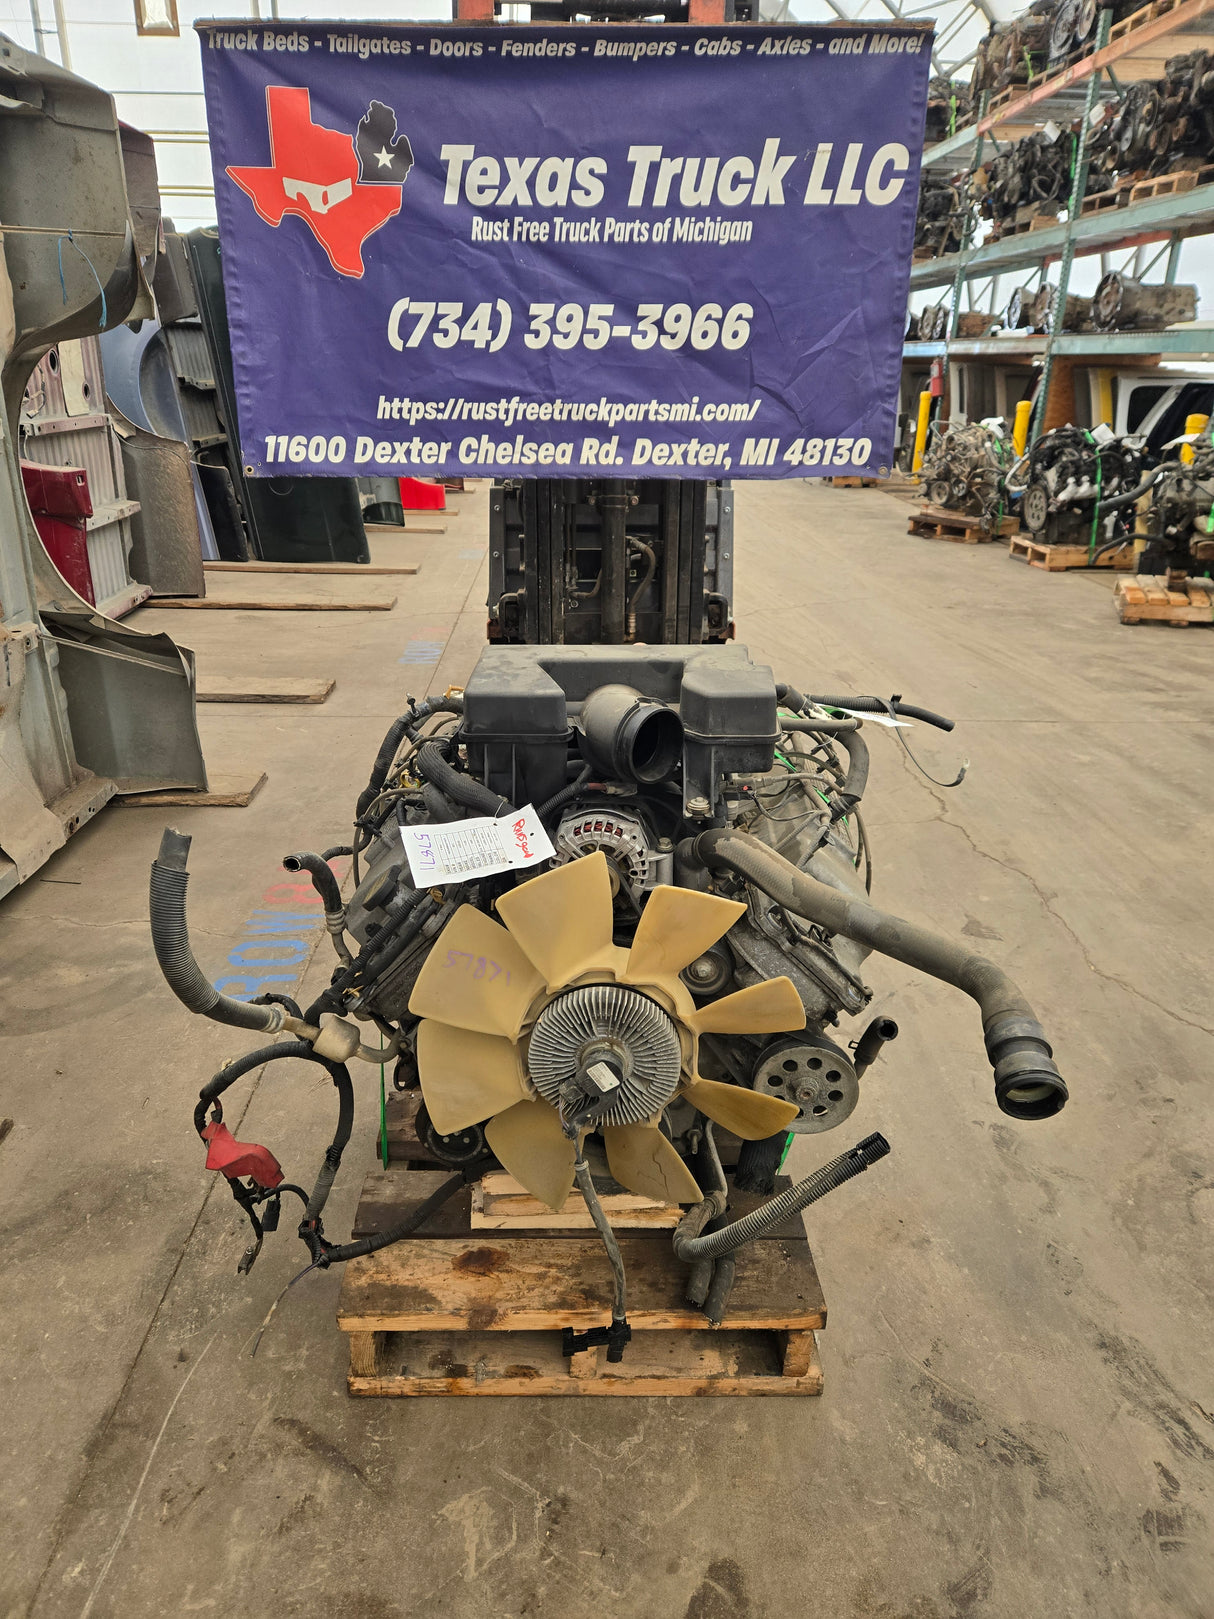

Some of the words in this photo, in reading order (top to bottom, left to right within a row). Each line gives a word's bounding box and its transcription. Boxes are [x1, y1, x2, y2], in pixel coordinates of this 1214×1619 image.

[206, 29, 258, 51] Truck
[262, 33, 309, 52] Beds
[327, 37, 411, 59] Tailgates
[430, 39, 483, 57] Doors
[501, 38, 577, 57] Fenders
[593, 39, 677, 62] Bumpers
[694, 37, 743, 56] Cabs
[757, 36, 812, 55] Axles
[828, 35, 866, 55] and
[868, 35, 924, 54] More!
[439, 144, 608, 207] Texas
[626, 137, 798, 208] Truck
[803, 143, 910, 207] LLC
[471, 216, 511, 243] Rust
[512, 217, 550, 243] Free
[554, 217, 602, 243] Truck
[603, 217, 651, 243] Parts
[652, 216, 672, 244] of
[672, 216, 753, 246] Michigan
[387, 296, 513, 353] (734)
[523, 302, 754, 351] 395-3966
[376, 395, 762, 428] https://rustfreetruckpartsmi.com/
[264, 435, 347, 463] 11600
[353, 436, 453, 465] Dexter
[458, 435, 575, 466] Chelsea
[578, 436, 624, 467] Rd.
[630, 437, 733, 471] Dexter,
[739, 437, 781, 467] MI
[782, 437, 873, 467] 48130
[413, 832, 436, 871] 57871
[213, 909, 327, 1003] ROW
[442, 949, 511, 987] 57871
